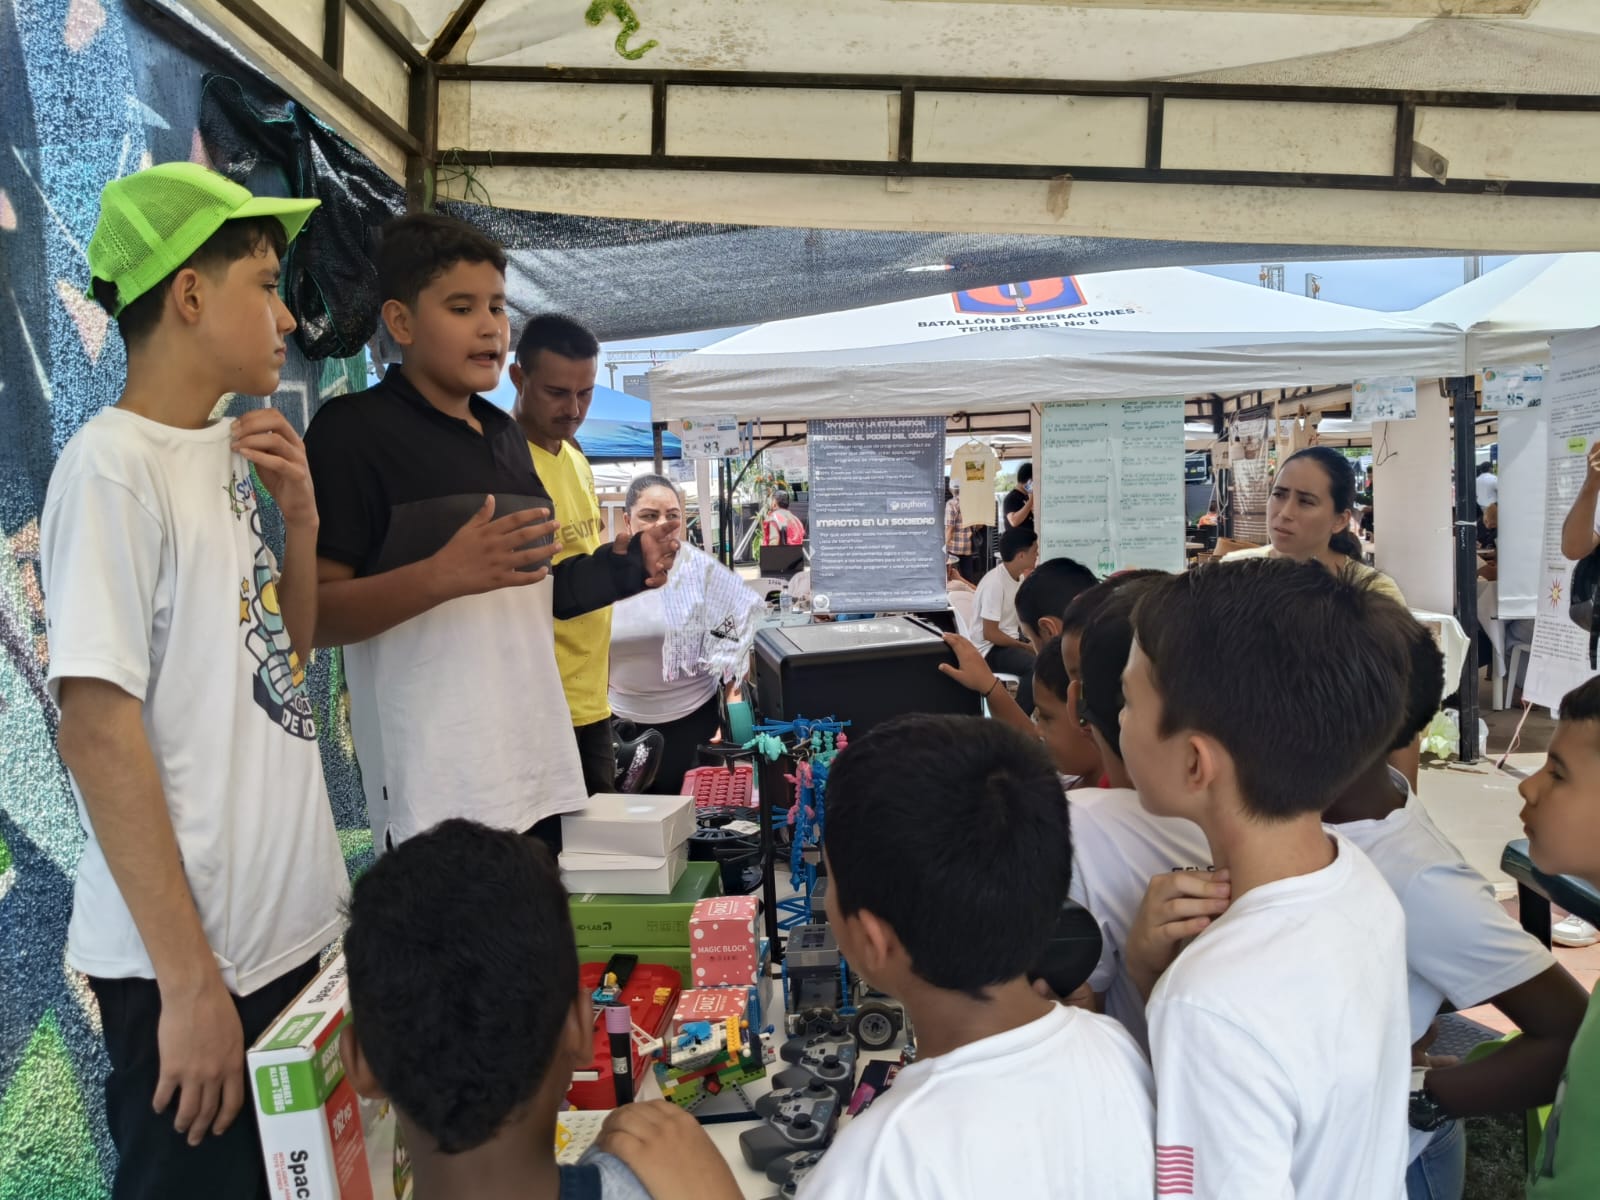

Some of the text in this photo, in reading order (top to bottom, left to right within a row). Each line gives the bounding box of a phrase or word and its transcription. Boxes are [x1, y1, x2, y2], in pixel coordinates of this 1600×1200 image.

[917, 308, 1136, 328] BATALLÓN DE OPERACIONES
[958, 322, 1060, 334] TERRESTRES
[703, 441, 720, 454] 83
[900, 500, 927, 510] python
[816, 517, 936, 528] IMPACTO EN LA SOCIEDAD
[698, 944, 747, 953] MAGIC BLOCK
